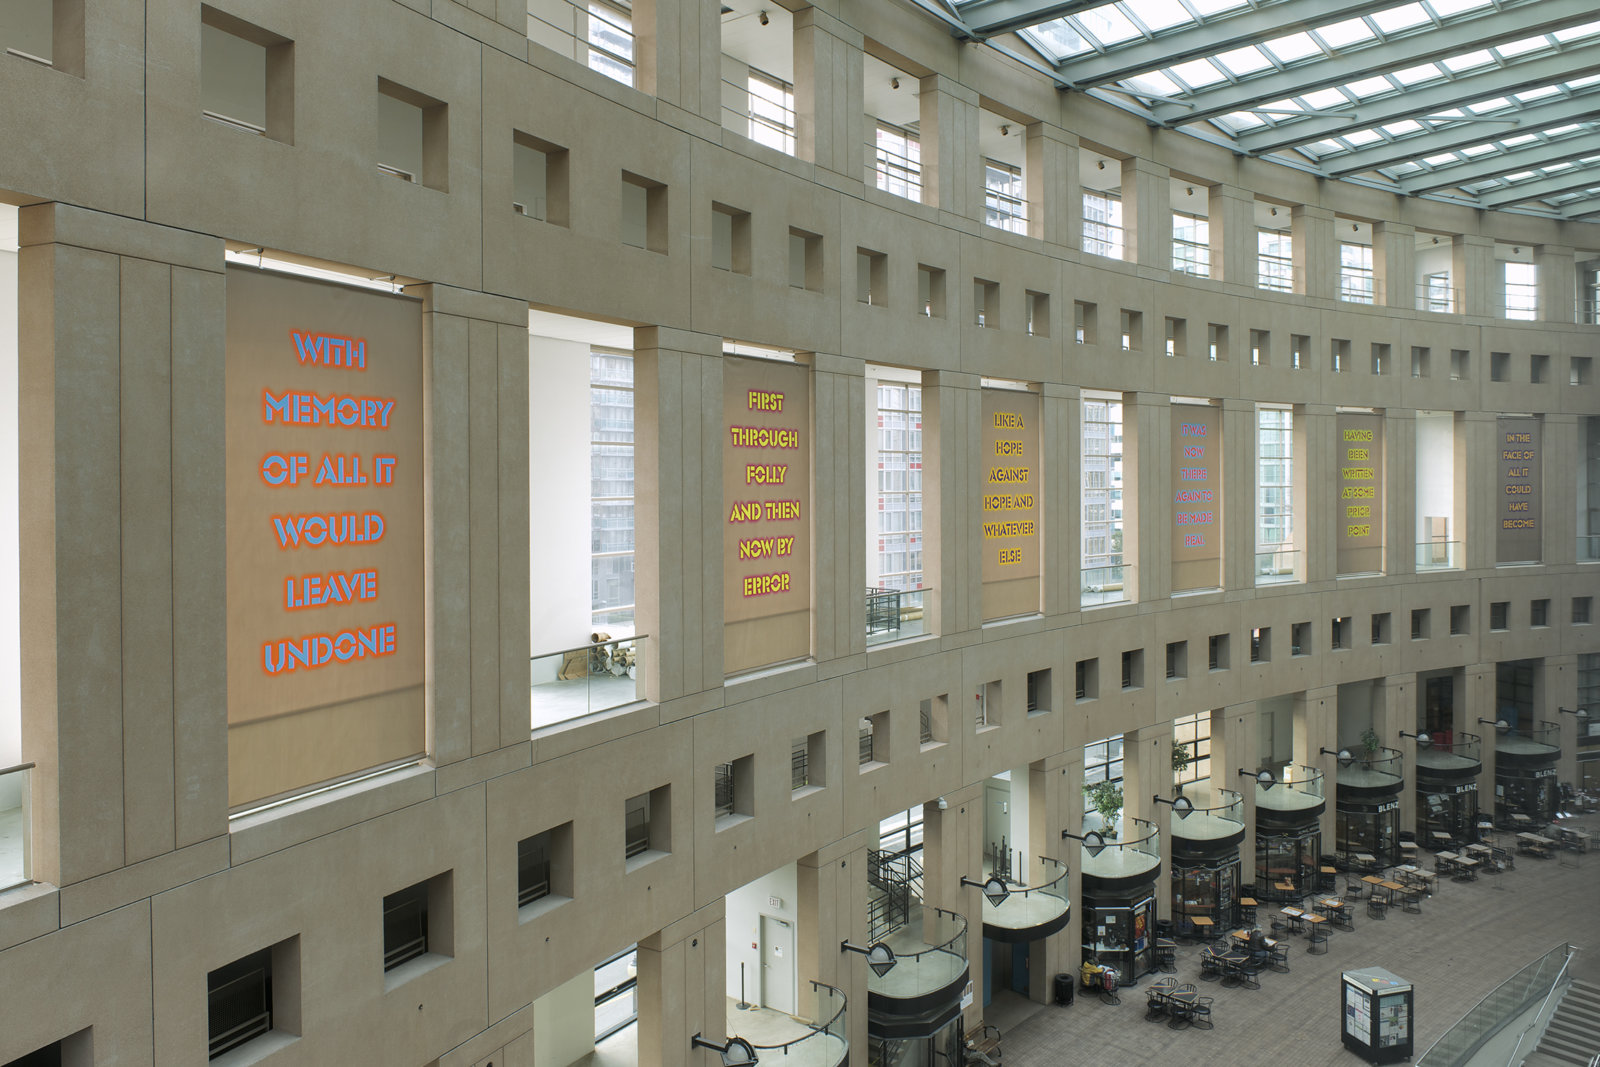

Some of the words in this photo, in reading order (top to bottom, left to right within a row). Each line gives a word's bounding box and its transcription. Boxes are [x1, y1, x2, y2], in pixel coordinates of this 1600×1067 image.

[291, 332, 366, 369] WITH
[748, 391, 784, 411] FIRST
[264, 391, 395, 428] MEMORY
[994, 413, 1015, 428] LIKE
[1016, 415, 1024, 429] A
[1182, 424, 1189, 436] IT
[1189, 424, 1207, 437] WAS
[1344, 430, 1373, 441] HAVING
[730, 427, 798, 448] THROUGH
[1506, 433, 1515, 443] IN
[1516, 433, 1531, 443] THE
[995, 441, 1023, 455] HOPE
[1184, 446, 1204, 458] NOW
[1348, 449, 1369, 460] BEEN
[1503, 450, 1522, 460] FACE
[1523, 450, 1535, 460] OF
[262, 454, 309, 486] OF
[314, 455, 367, 485] ALL
[375, 456, 397, 484] IT
[746, 465, 787, 484] FOLLY
[989, 468, 1029, 482] AGAINST
[1181, 468, 1207, 480] THERE
[1342, 468, 1374, 479] WRITTEN
[1508, 467, 1520, 477] ALL
[1522, 467, 1529, 477] IT
[1342, 487, 1352, 498] AT
[1353, 487, 1374, 498] SOME
[1505, 484, 1532, 494] COULD
[1175, 490, 1201, 502] AGAIN
[1202, 490, 1213, 502] TO
[984, 496, 1012, 510] HOPE
[1013, 495, 1034, 509] AND
[1508, 502, 1529, 511] HAVE
[729, 502, 762, 522] AND
[765, 501, 800, 520] THEN
[1347, 506, 1370, 518] PRIOR
[1177, 513, 1188, 525] BE
[1189, 512, 1213, 524] MADE
[1503, 519, 1535, 529] BECOME
[272, 514, 385, 548] WOULD
[983, 521, 1034, 537] WHATEVER
[1348, 525, 1369, 537] POINT
[1185, 535, 1205, 547] REAL
[739, 538, 774, 559] NOW
[777, 536, 794, 555] BY
[999, 549, 1021, 564] ELSE
[286, 571, 377, 609] LEAVE
[743, 573, 790, 597] ERROR
[263, 625, 396, 674] UNDONE
[1535, 768, 1557, 778] BLENZ
[1456, 783, 1477, 794] BLENZ
[1378, 801, 1399, 813] BLENZ
[769, 897, 779, 907] EXIT
